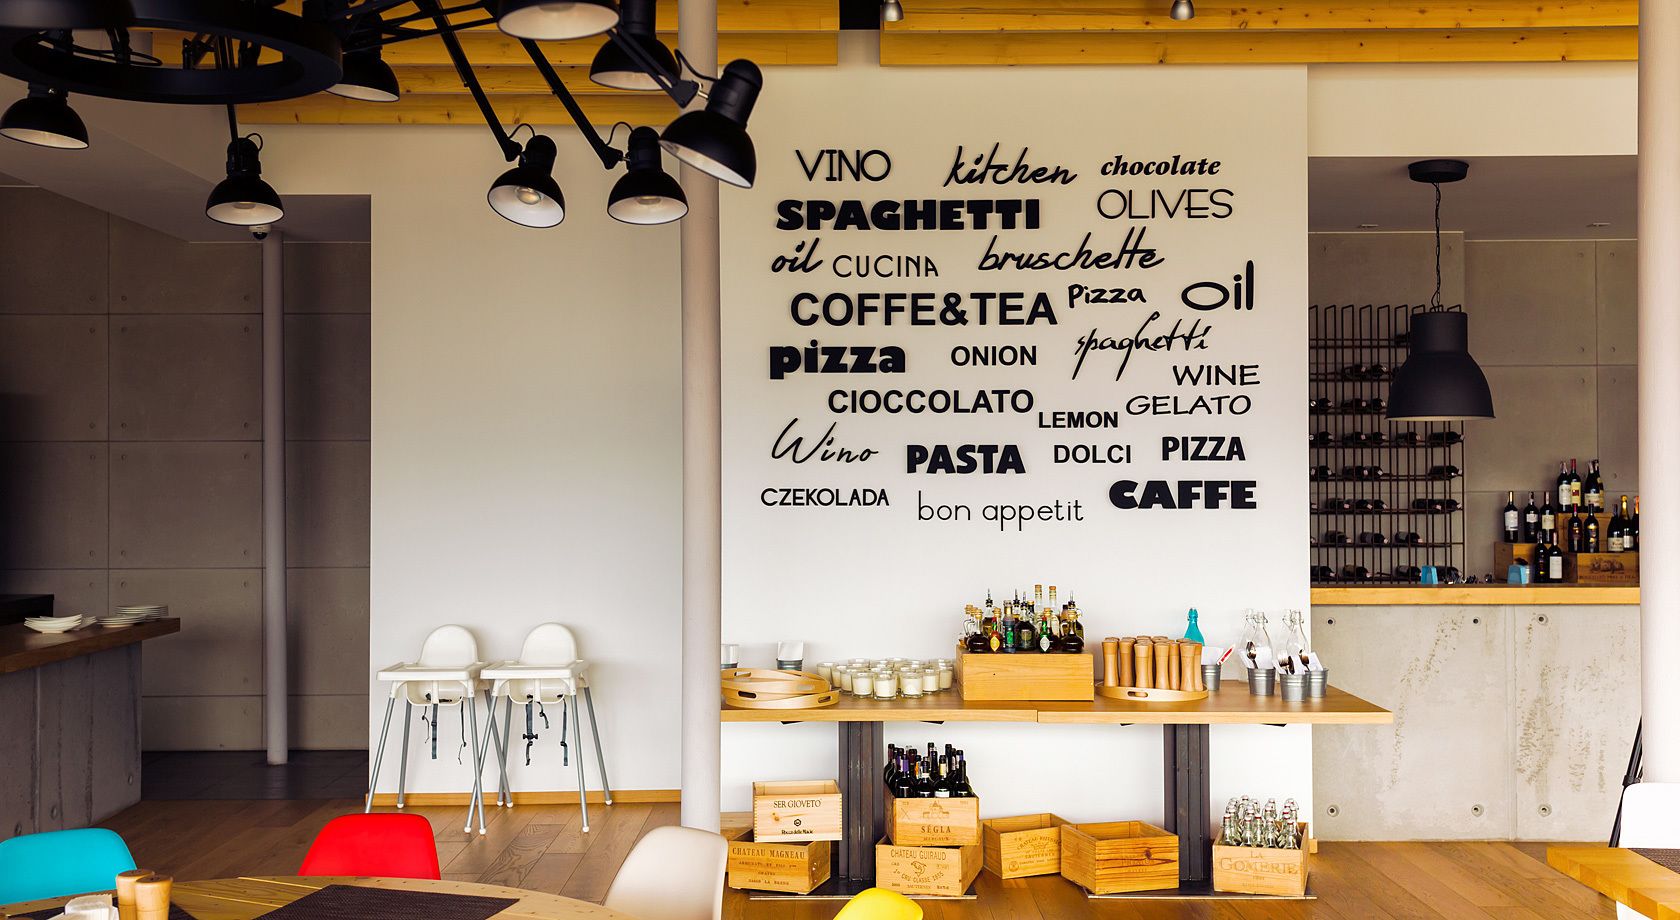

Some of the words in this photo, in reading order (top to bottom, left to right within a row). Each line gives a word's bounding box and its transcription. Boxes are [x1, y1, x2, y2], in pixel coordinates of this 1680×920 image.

[794, 148, 892, 182] VINO
[942, 141, 1078, 188] kitchen
[1100, 154, 1222, 176] chocolate
[775, 198, 1040, 231] SPAGHETTI
[1096, 188, 1235, 220] OLIVES
[770, 237, 824, 274] oil
[977, 225, 1166, 271] bruschette
[832, 254, 939, 278] CUCINA
[1180, 259, 1255, 311] oil
[790, 291, 1059, 327] COFFE&TEA
[769, 338, 906, 380] pizza
[950, 345, 1037, 367] ONION
[1071, 310, 1212, 382] spaghetti
[1172, 364, 1261, 387] WINE
[827, 389, 1034, 414] CIOCCOLATO
[1125, 394, 1252, 416] GELATO
[1038, 410, 1119, 429] LEMON
[771, 417, 879, 464] Wino
[1053, 444, 1131, 464] DOLCI
[1161, 436, 1246, 461] PIZZA
[906, 443, 1027, 475] PASTA
[760, 487, 890, 507] CZEKOLADA
[1108, 479, 1257, 510] CAFFE
[918, 490, 971, 521] bon
[982, 499, 1084, 532] appetit
[773, 800, 787, 809] SER
[787, 799, 821, 808] GIOVETO
[732, 847, 766, 857] CHATEAU
[769, 849, 805, 860] MAGNEAU
[919, 850, 947, 861] GUIRAUD
